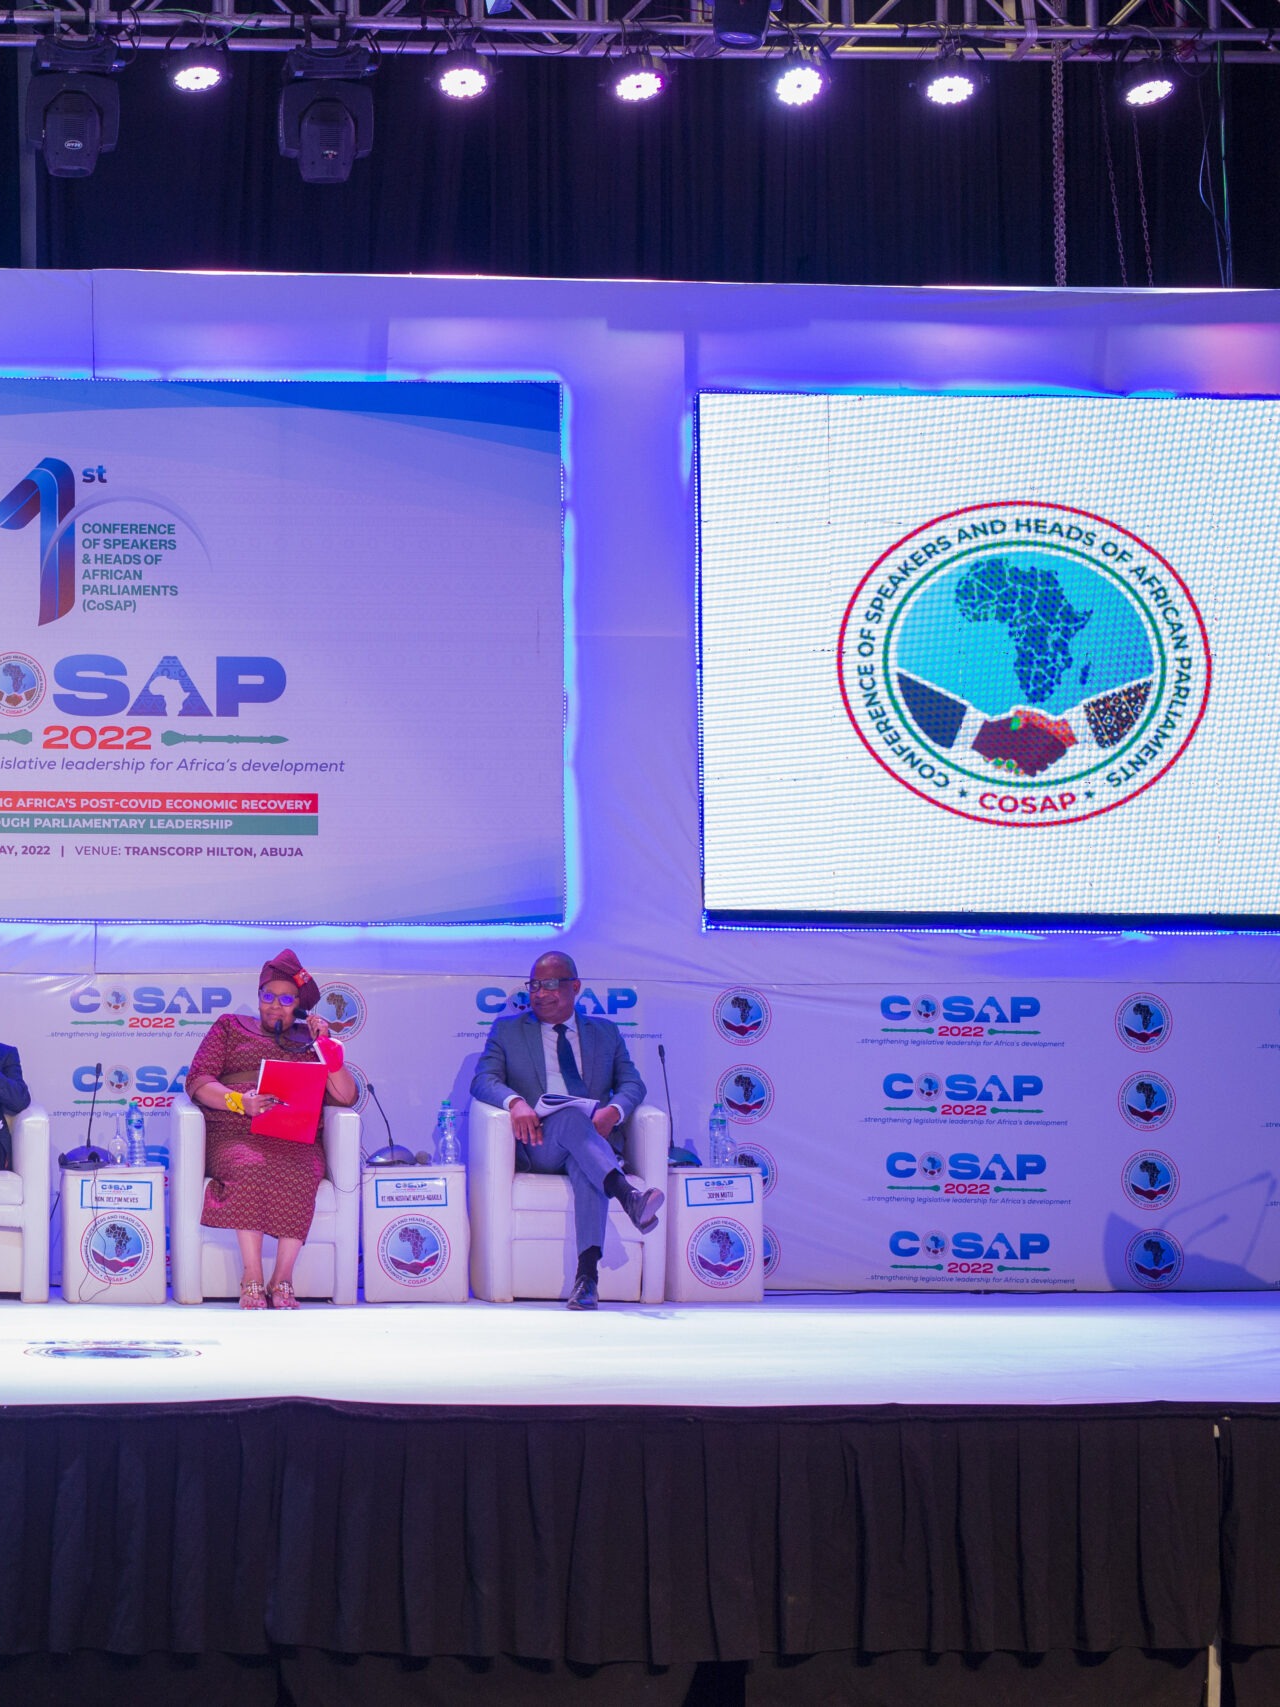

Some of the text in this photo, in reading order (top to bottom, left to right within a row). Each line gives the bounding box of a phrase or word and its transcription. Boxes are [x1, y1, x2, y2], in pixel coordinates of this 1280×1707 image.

[82, 523, 176, 535] CONFERENCE
[82, 539, 177, 550] OF SPEAKERS
[82, 554, 163, 565] & HEADS OF
[82, 569, 142, 580] AFRICAN
[82, 585, 178, 596] PARLIAMENTS
[82, 600, 137, 612] (CoSAP)
[857, 518, 1192, 788] CONFERENCE OF SPEAKERS AND HEADS OF AFRICAN PARLIAMENTS
[42, 725, 151, 750] 2022
[61, 758, 145, 773] leadership
[150, 758, 173, 771] for
[177, 758, 237, 772] Africa's
[241, 759, 345, 775] development
[16, 798, 76, 809] AFRICA'S
[81, 798, 162, 809] POST-COVID
[166, 800, 237, 810] ECONOMIC
[241, 800, 312, 810] RECOVERY
[978, 792, 1076, 814] COSAP
[34, 818, 146, 829] PARLIAMENTARY
[149, 819, 233, 830] LEADERSHIP
[21, 845, 50, 856] 2022
[75, 846, 121, 856] VENUE:
[125, 847, 202, 857] TRANSCORP
[207, 848, 257, 859] HILTON,
[260, 848, 303, 857] ABUJA
[70, 986, 232, 1014] COSAP
[880, 995, 1041, 1023] COSAP
[128, 1017, 175, 1028] 2022
[100, 1031, 134, 1039] legislative
[136, 1031, 172, 1039] leadership
[938, 1026, 984, 1037] 2022
[910, 1039, 944, 1047] legislative
[1021, 1041, 1065, 1049] development
[883, 1073, 1044, 1102] COSAP
[941, 1105, 987, 1116] 2022
[948, 1118, 984, 1126] leadership
[886, 1152, 1046, 1181] COSAP
[944, 1183, 990, 1195] 2022
[916, 1196, 950, 1204] legislative
[952, 1197, 987, 1205] leadership
[1027, 1198, 1071, 1206] development
[889, 1231, 1050, 1260] COSAP
[947, 1262, 993, 1274] 2022
[920, 1275, 953, 1283] legislative
[955, 1276, 990, 1284] leadership
